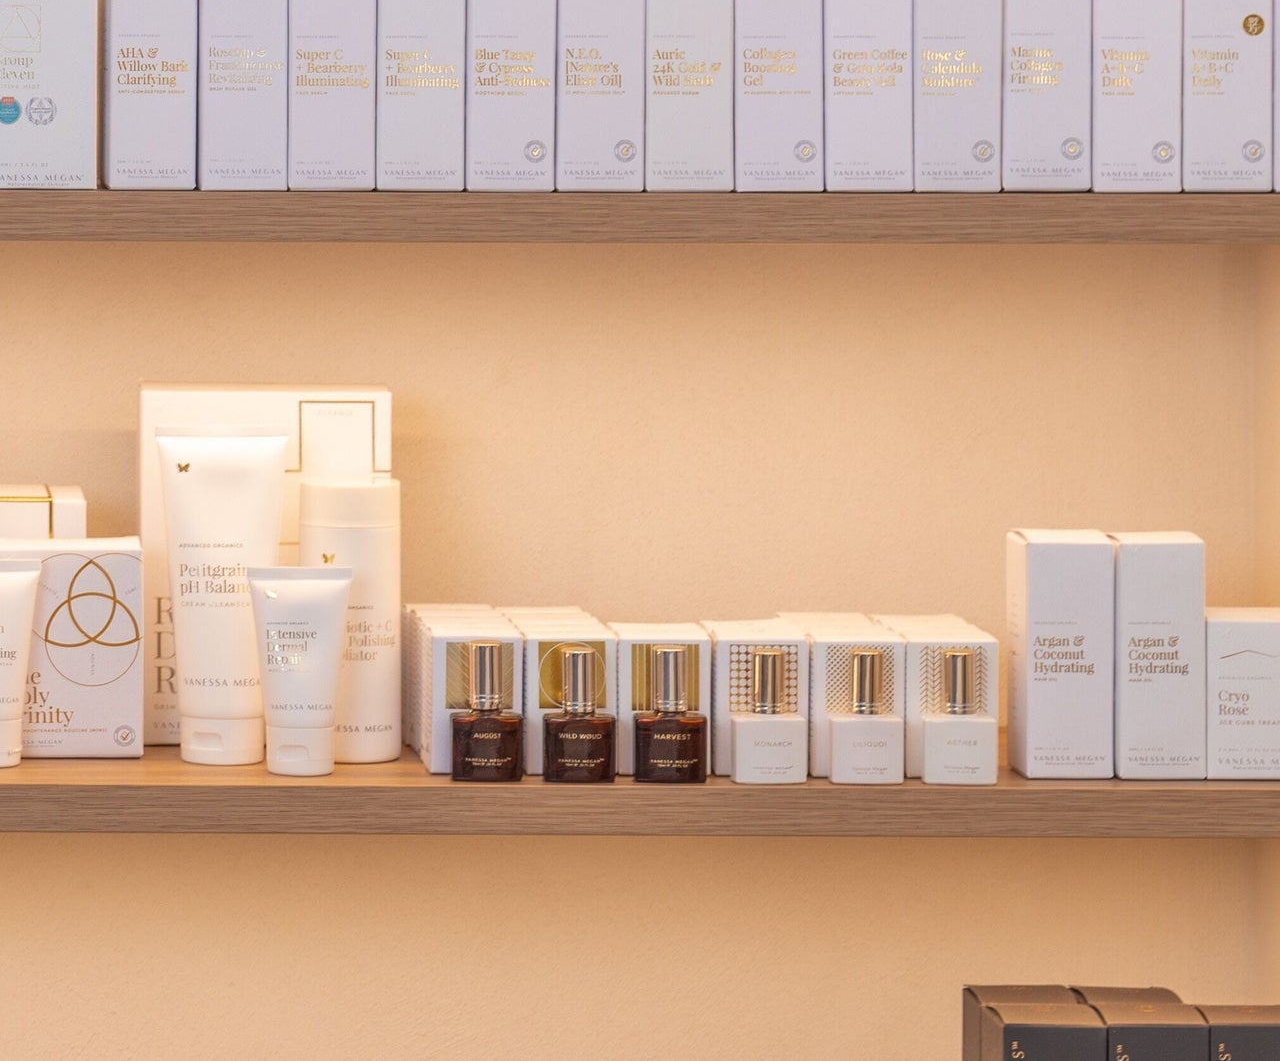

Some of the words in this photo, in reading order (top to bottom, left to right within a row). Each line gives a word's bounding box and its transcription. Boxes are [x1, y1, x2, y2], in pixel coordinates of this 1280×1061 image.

[117, 47, 144, 59] AHA
[147, 47, 160, 59] &
[295, 48, 331, 63] Super
[333, 49, 343, 60] C
[475, 48, 500, 60] Blue
[565, 47, 602, 60] N.E.O.
[652, 48, 686, 60] Auric
[832, 48, 868, 60] Green
[870, 48, 908, 60] Coffee
[117, 60, 159, 72] Willow
[161, 60, 189, 72] Bark
[306, 62, 367, 76] Bearberry
[653, 62, 674, 74] 24K
[117, 73, 177, 88] Clarifying
[295, 75, 370, 89] Illuminating
[652, 75, 681, 87] Wild
[743, 75, 764, 87] Gel
[266, 628, 317, 640] Intensive
[266, 641, 308, 653] Dermal
[1034, 635, 1070, 649] Argan
[1073, 635, 1085, 647] &
[267, 653, 304, 667] Repair
[1034, 648, 1085, 661] Coconut
[1034, 661, 1095, 676] Hydrating
[1218, 689, 1250, 704] Cryo
[558, 732, 578, 740] WILD
